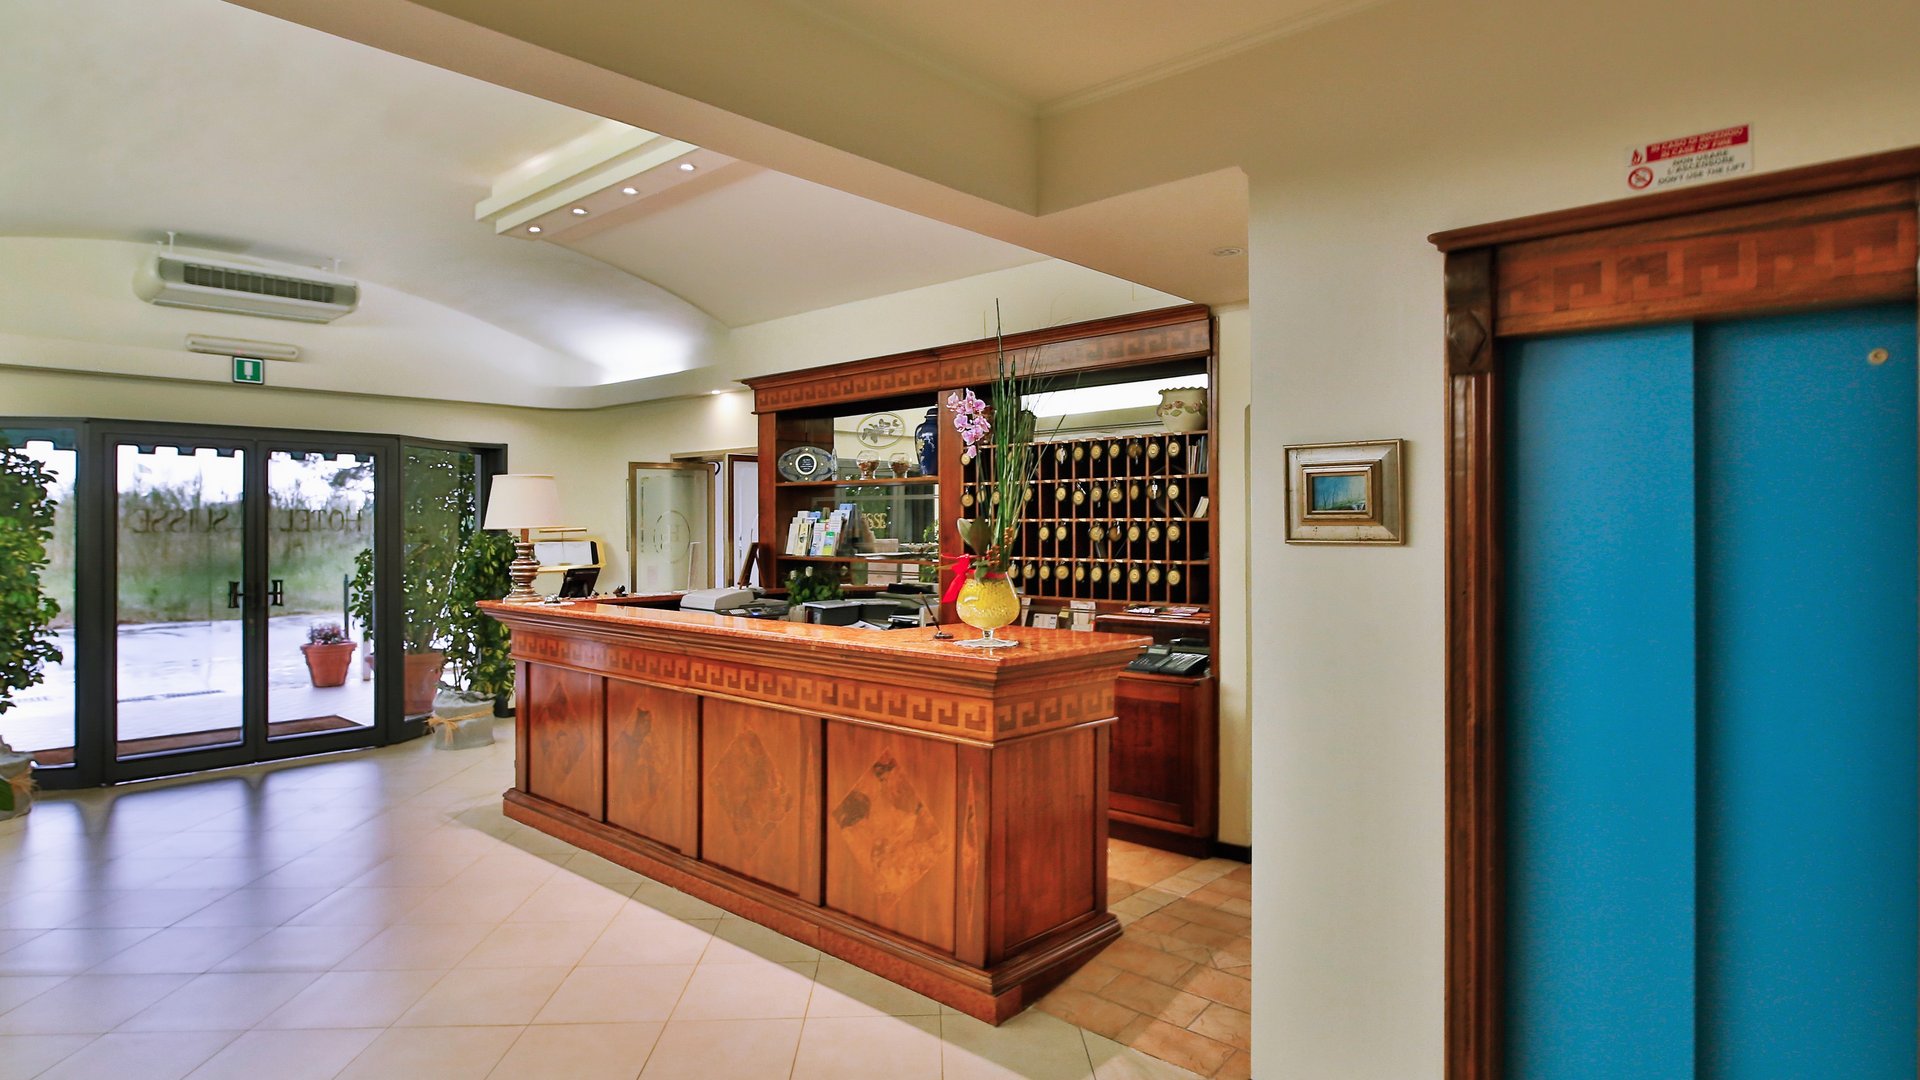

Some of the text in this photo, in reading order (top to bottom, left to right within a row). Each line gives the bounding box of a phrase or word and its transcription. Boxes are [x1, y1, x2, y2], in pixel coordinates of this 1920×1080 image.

[1651, 128, 1743, 153] IN CASO DI INCENDIO
[1661, 138, 1732, 158] IN CASE OF FIRE
[1672, 150, 1728, 166] NON USARE
[1658, 163, 1745, 185] DON'T USE THE LIFT
